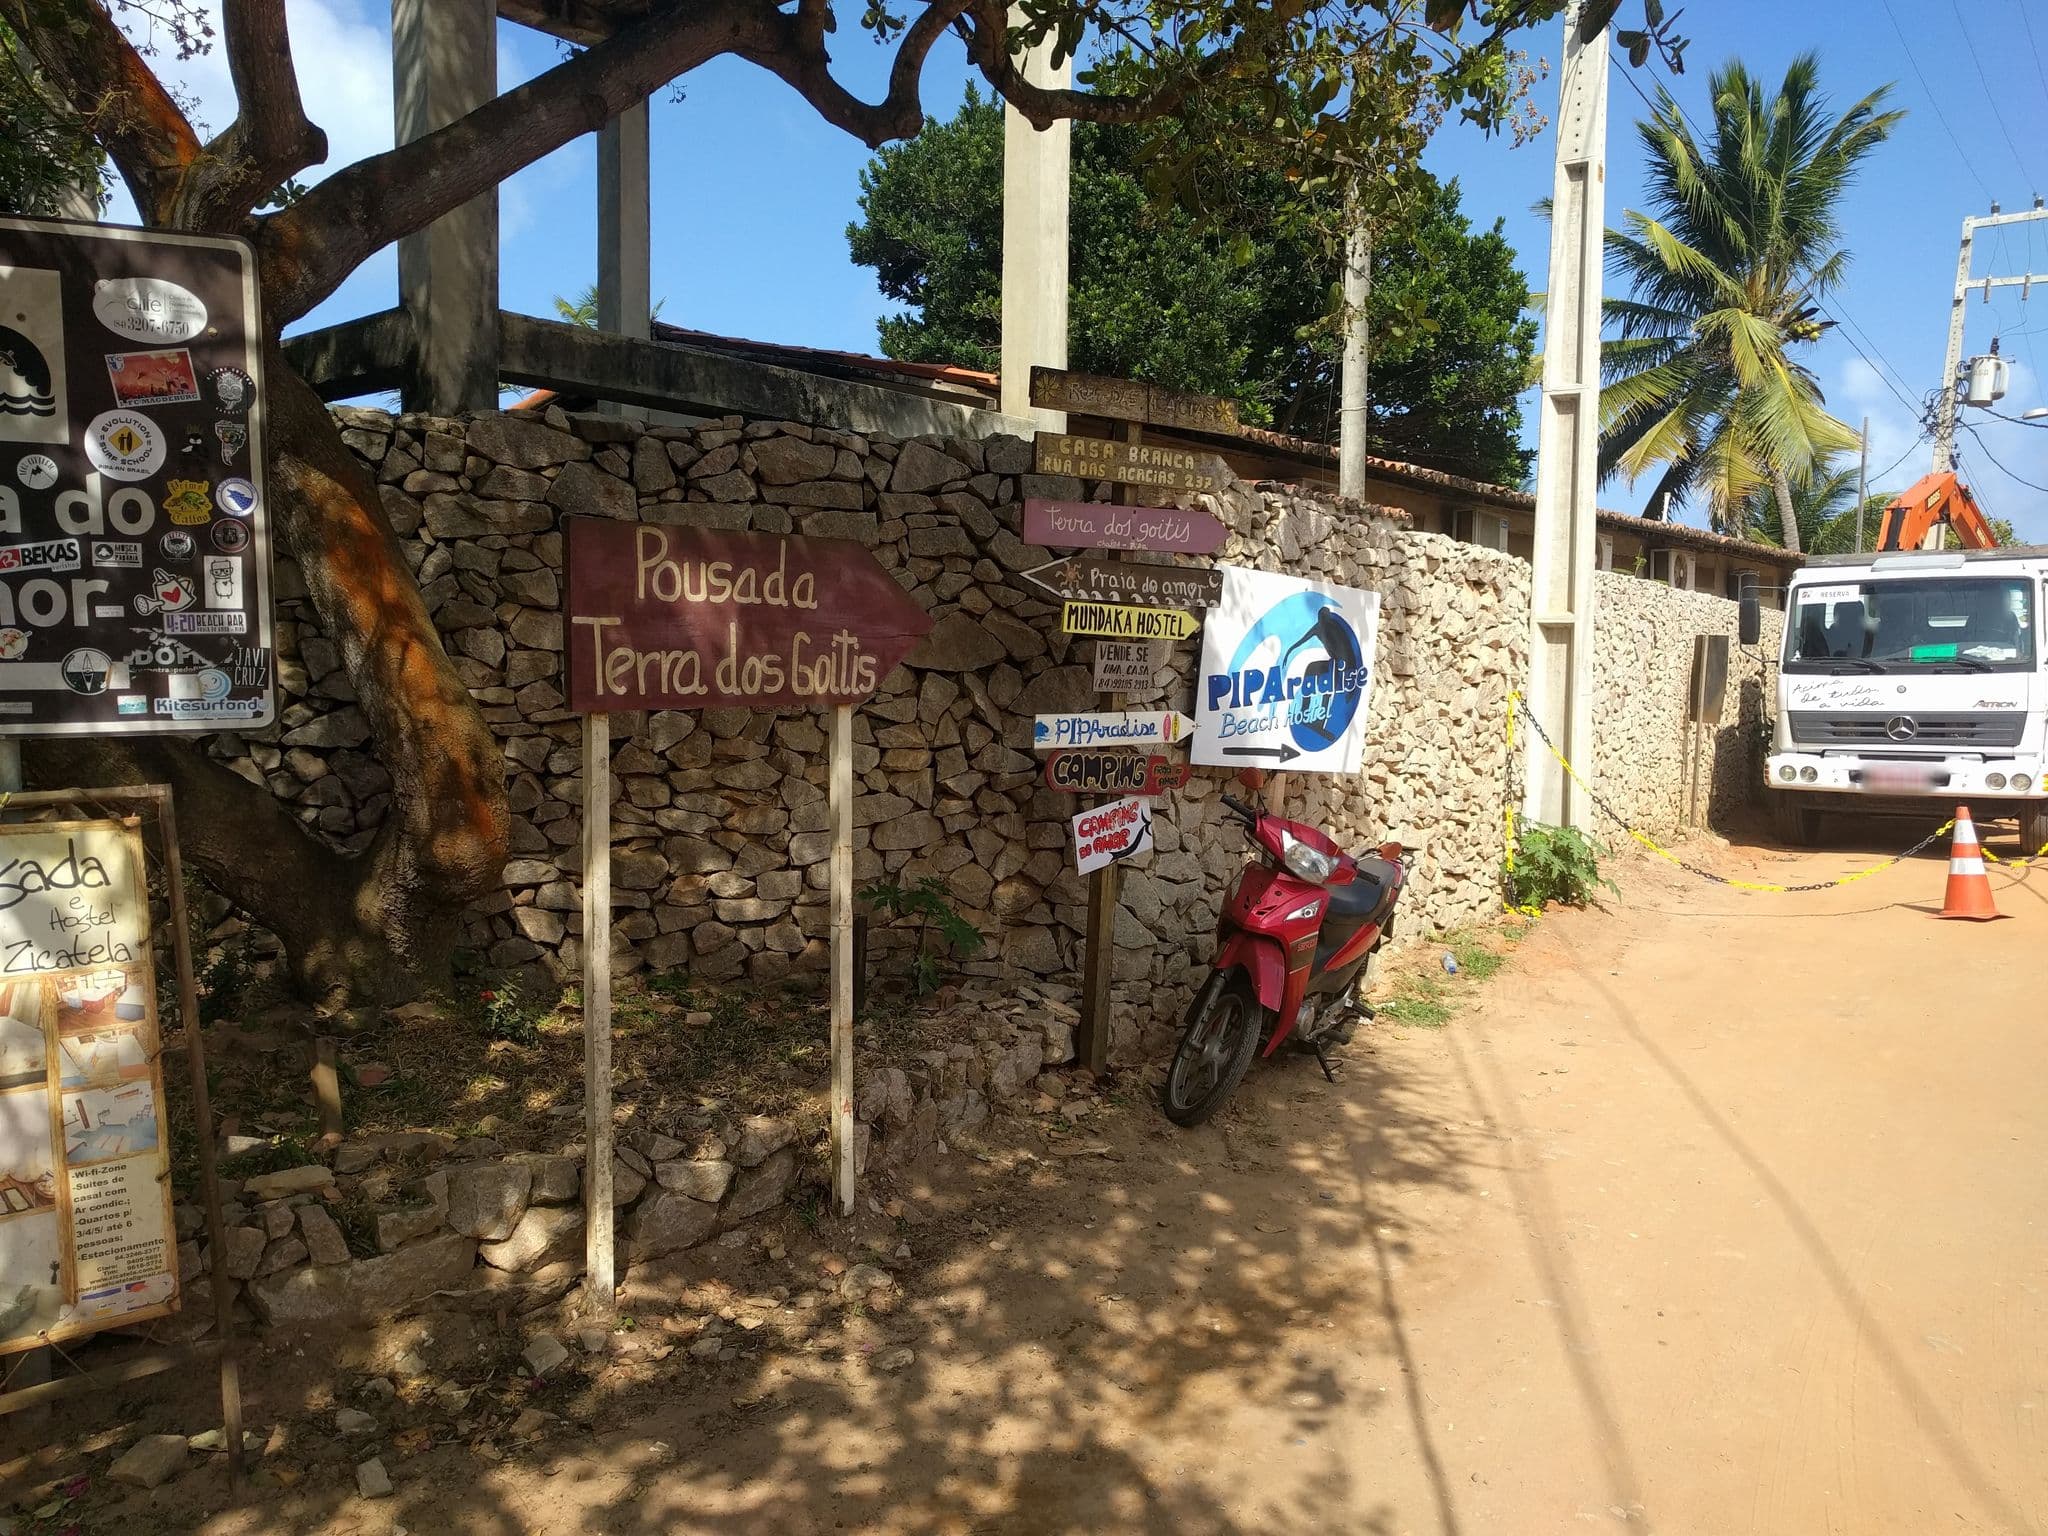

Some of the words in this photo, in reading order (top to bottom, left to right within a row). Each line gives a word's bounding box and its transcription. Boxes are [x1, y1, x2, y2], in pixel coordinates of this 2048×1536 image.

[101, 417, 152, 438] EVOLUTION
[99, 442, 119, 462] SURF
[120, 448, 153, 466] SCHOOL
[1059, 437, 1115, 459] CASA
[1129, 446, 1195, 470] BRANCA
[1043, 456, 1073, 472] RUA
[1079, 460, 1106, 477] DAS
[1184, 474, 1213, 489] 237
[55, 472, 155, 535] do
[1044, 506, 1096, 533] Terra
[1104, 512, 1131, 536] dos
[1136, 518, 1191, 544] goitis
[21, 542, 79, 566] BEKAS
[635, 525, 818, 610] Pousada
[1090, 568, 1137, 591] Praia
[1141, 575, 1158, 594] do
[1162, 580, 1209, 598] amor
[166, 614, 196, 632] 4:20
[196, 614, 224, 627] BEACH
[227, 614, 244, 626] BAR
[1066, 603, 1133, 634] MUNDAKA
[1137, 610, 1185, 638] HOSTEL
[235, 647, 265, 666] JAVI
[571, 616, 709, 697] Terra
[714, 621, 785, 697] dos
[234, 667, 266, 687] CRUZ
[1126, 665, 1150, 676] CASA
[1218, 711, 1279, 739] Beach
[1284, 695, 1333, 728] Hostel
[1053, 753, 1148, 790] CAMPING
[1078, 801, 1140, 838] CAMPING
[1092, 828, 1131, 854] AMOR
[70, 895, 85, 910] e
[50, 903, 117, 933] Hostel
[3, 931, 133, 973] Zicatela
[112, 1175, 125, 1184] de
[73, 1191, 102, 1203] casal
[105, 1188, 127, 1197] com
[75, 1207, 86, 1215] Ar
[106, 1223, 123, 1232] até
[126, 1220, 133, 1228] 6
